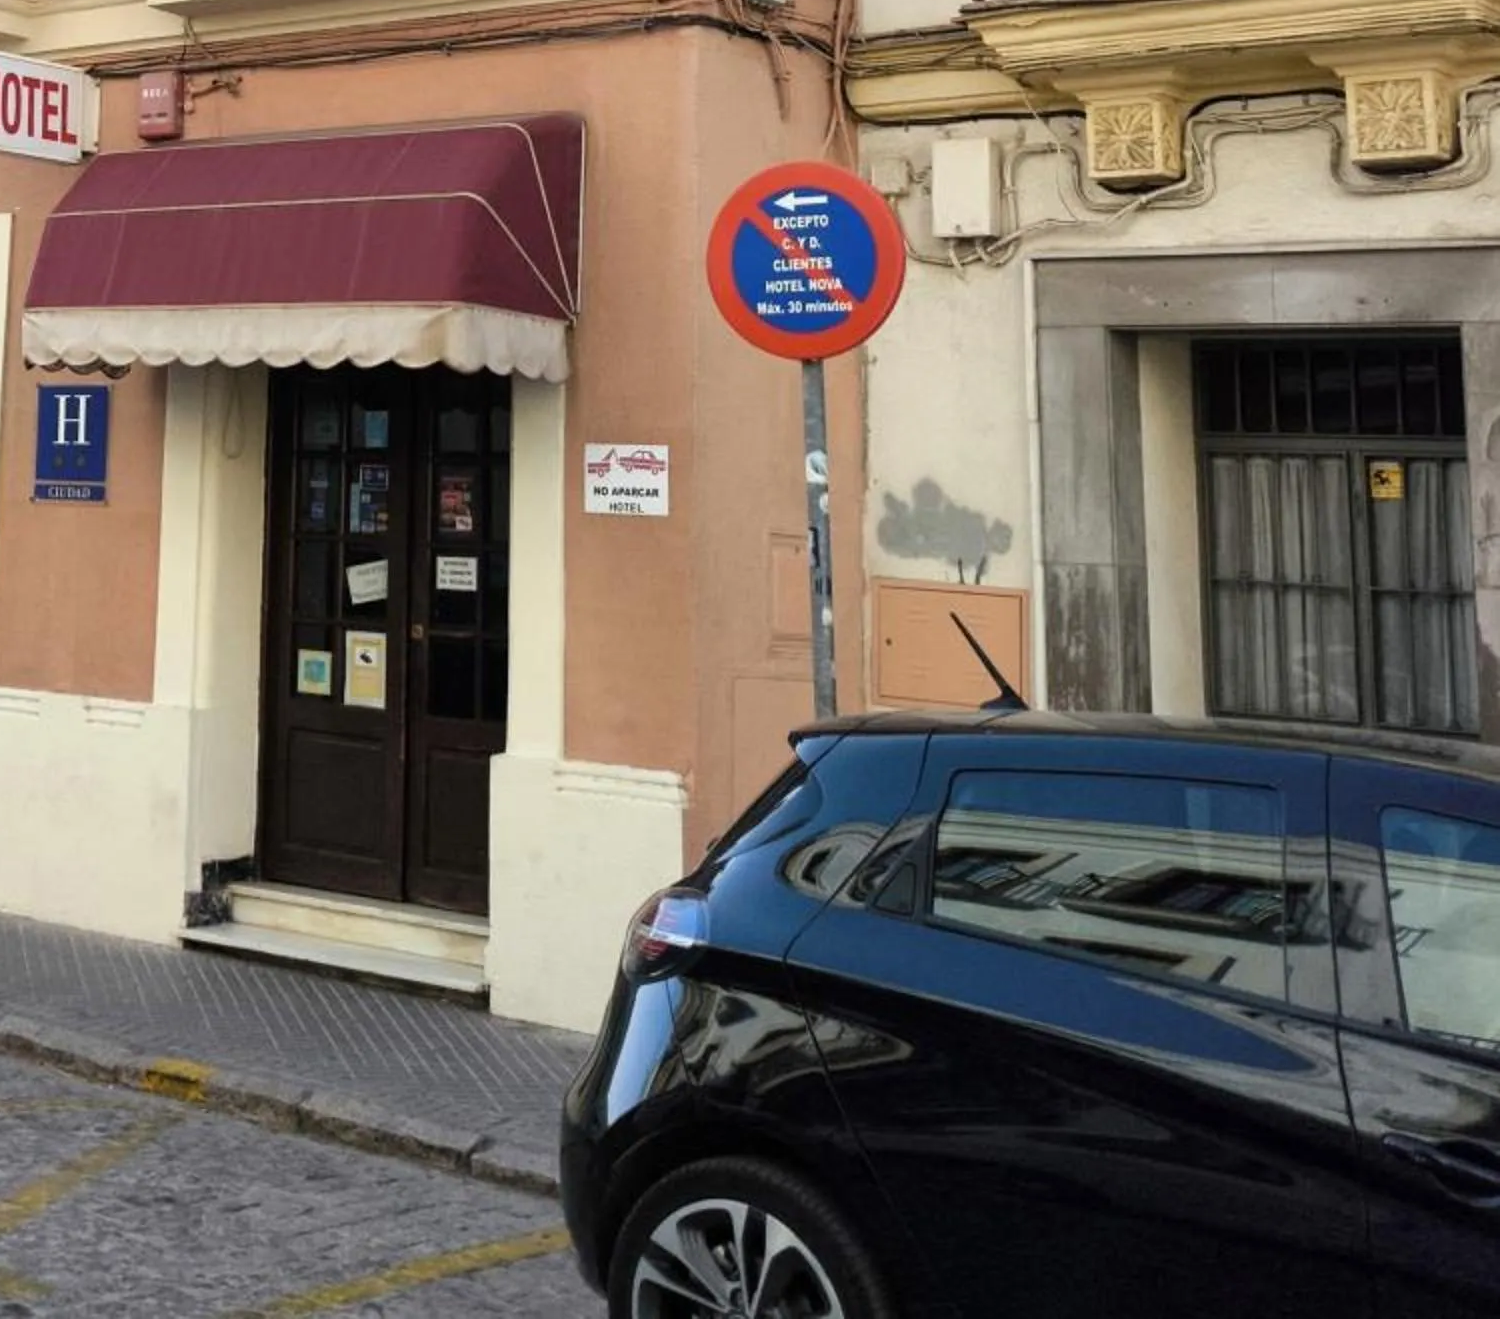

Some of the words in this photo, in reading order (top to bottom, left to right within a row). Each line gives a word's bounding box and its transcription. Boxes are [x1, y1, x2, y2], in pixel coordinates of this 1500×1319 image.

[773, 214, 829, 230] EXCEPTO
[798, 237, 805, 249] Y
[773, 256, 833, 272] CLIENTES
[765, 280, 805, 294] HOTEL
[809, 277, 843, 292] NOVA
[788, 301, 802, 313] 30
[805, 299, 853, 312] minutos
[51, 394, 92, 446] H
[593, 486, 609, 496] NO
[611, 487, 660, 498] APARCAR
[609, 503, 644, 513] HOTEL
